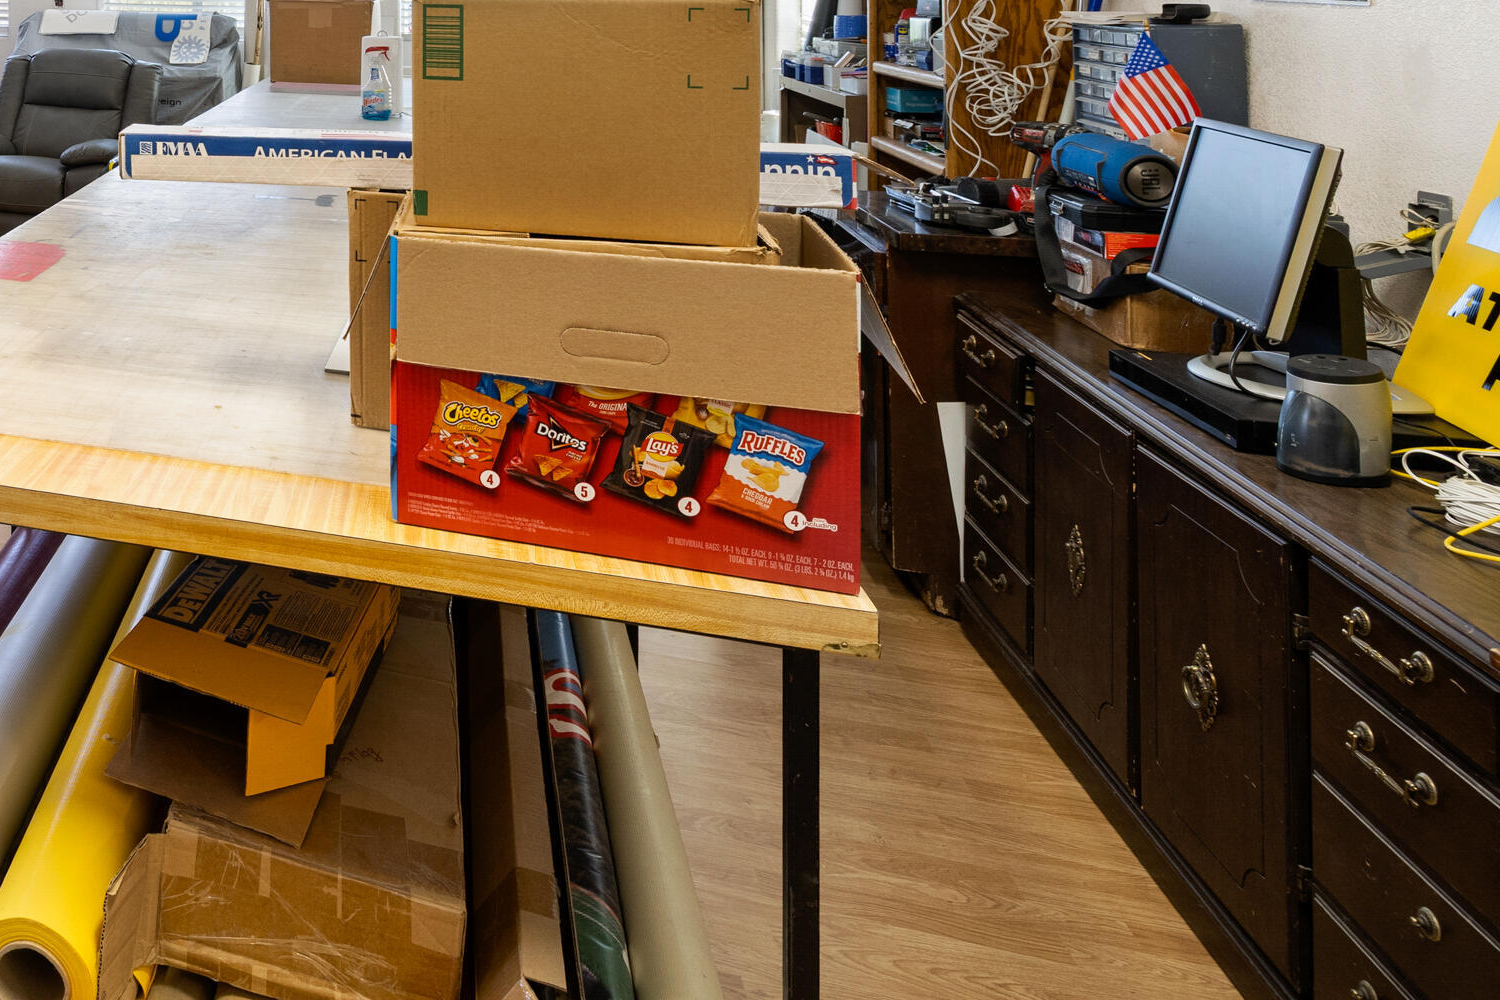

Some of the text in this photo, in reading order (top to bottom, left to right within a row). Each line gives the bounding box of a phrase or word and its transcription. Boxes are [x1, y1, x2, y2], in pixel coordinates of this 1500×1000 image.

[588, 400, 628, 412] The ORIGINA
[443, 402, 500, 428] Cheetos
[536, 421, 588, 452] Doritos
[645, 437, 679, 457] Lay's
[739, 431, 806, 465] RUFFLES
[486, 473, 494, 486] 4
[580, 485, 589, 498] 5
[742, 487, 773, 505] CHEDDAR
[684, 500, 693, 513] 4
[790, 514, 799, 528] 4
[802, 519, 838, 532] Including
[674, 536, 705, 550] INDIVIDUAL
[705, 541, 722, 552] BAGS:
[729, 554, 746, 565] TOTAL
[801, 565, 814, 575] LBS.
[161, 558, 234, 624] DEWALT
